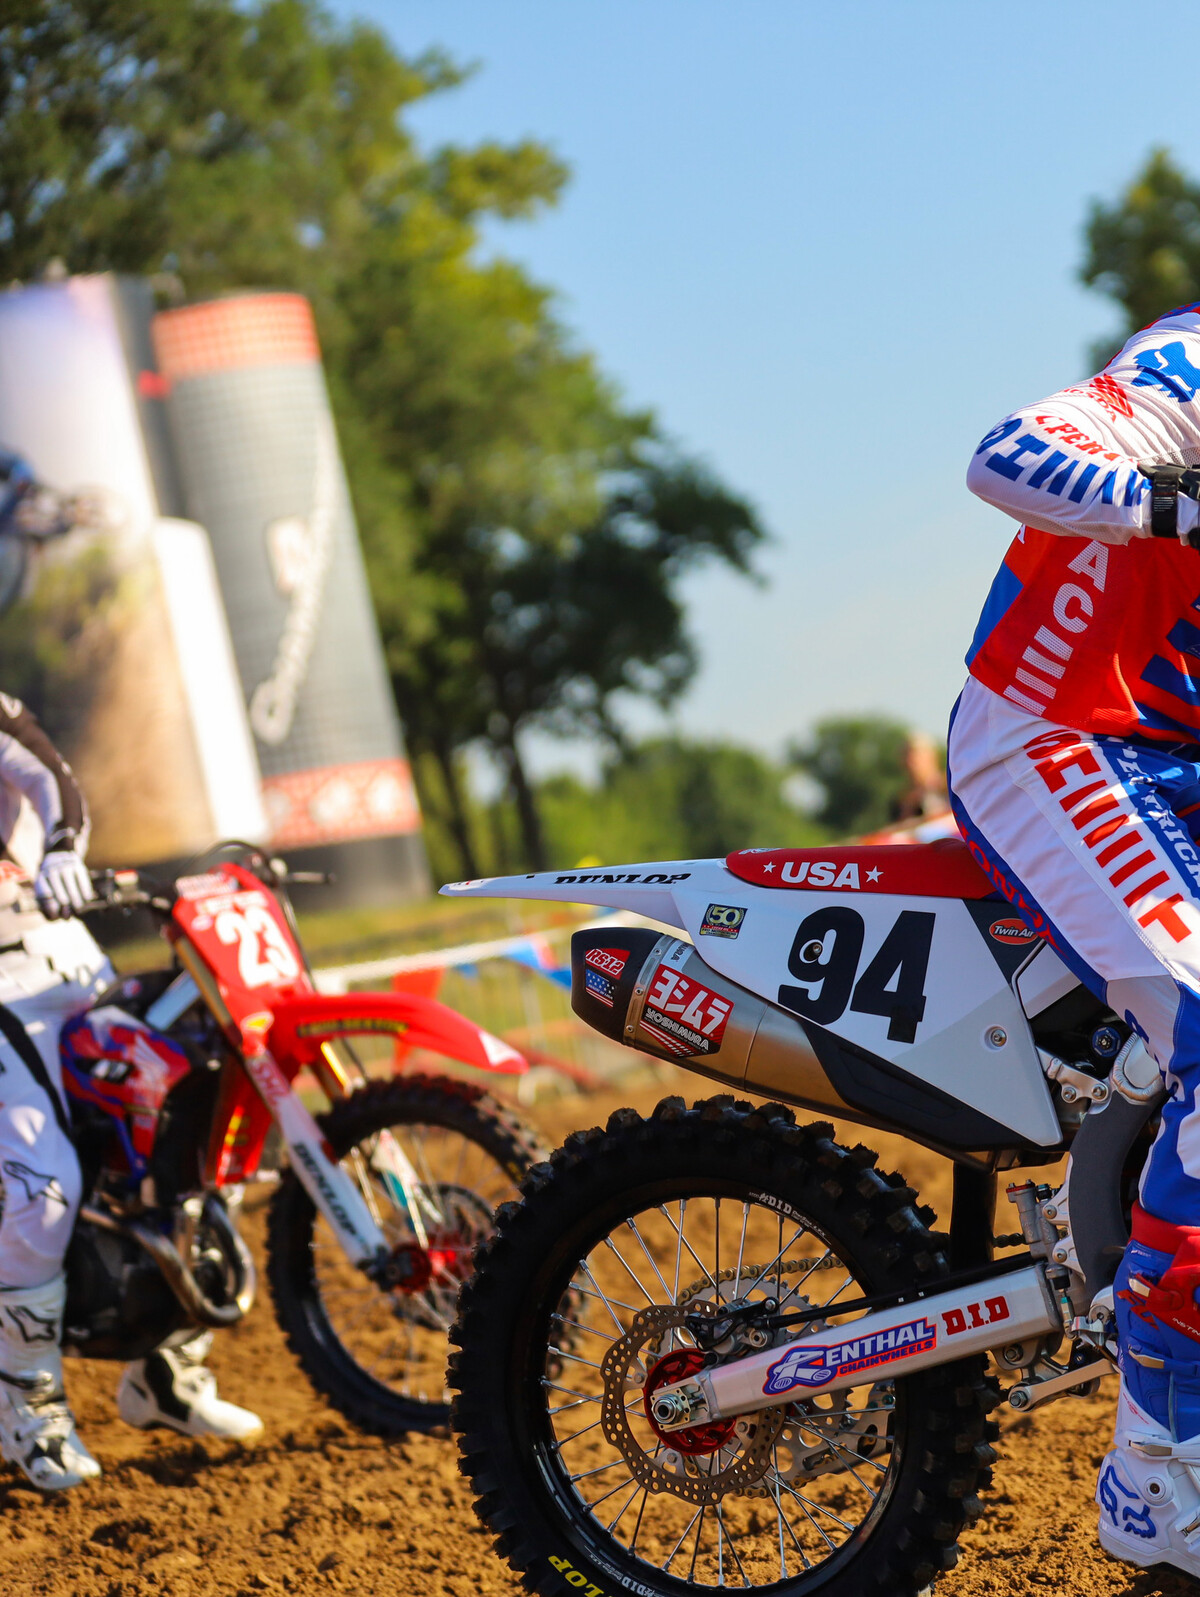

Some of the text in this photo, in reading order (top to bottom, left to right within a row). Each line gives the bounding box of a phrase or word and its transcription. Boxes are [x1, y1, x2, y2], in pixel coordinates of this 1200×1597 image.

[554, 873, 692, 885] DUNLOP
[780, 861, 861, 890] USA
[709, 906, 740, 926] 50
[993, 925, 1019, 937] Twin
[214, 904, 300, 991] 23
[778, 906, 936, 1044] 94
[647, 969, 731, 1035] ヨシムラ
[645, 1007, 710, 1051] YOSHIMURA
[941, 1295, 1011, 1337] D.I.D
[771, 1321, 934, 1390] RENTHAL
[839, 1339, 934, 1375] CHAINWHEELS
